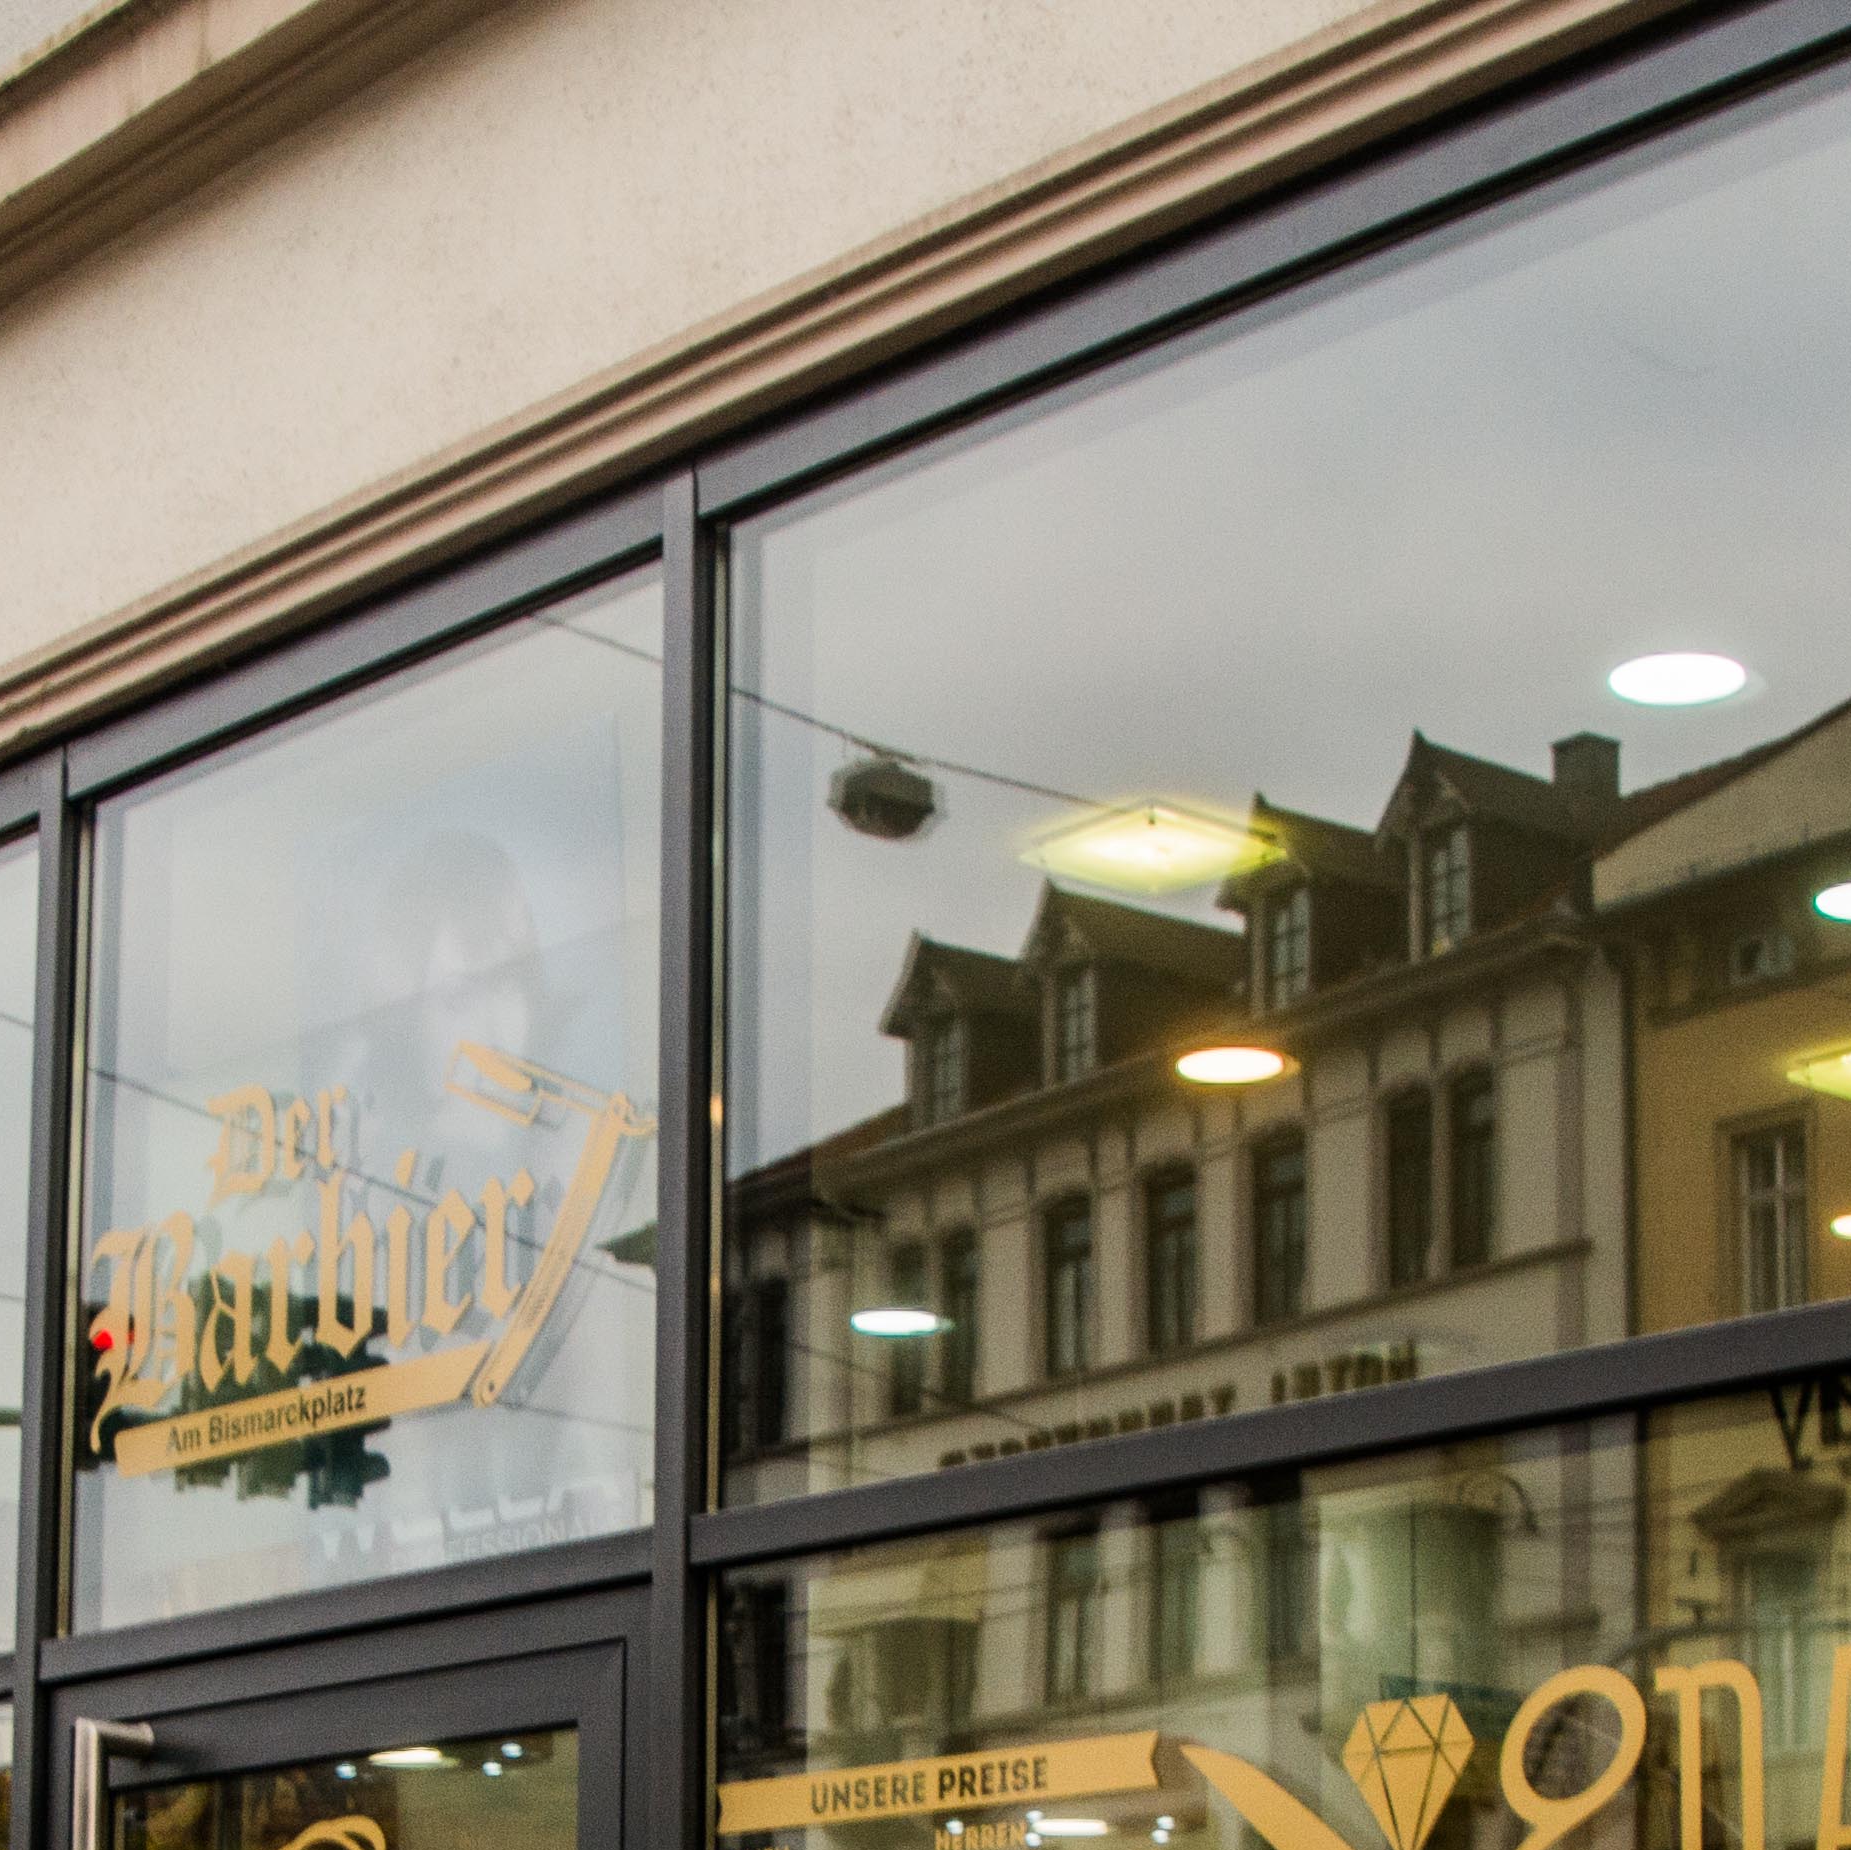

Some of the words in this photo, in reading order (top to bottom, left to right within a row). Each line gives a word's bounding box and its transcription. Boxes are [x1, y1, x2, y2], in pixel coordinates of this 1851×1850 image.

[206, 1084, 346, 1208] Der
[90, 1150, 535, 1453] Barbier
[166, 1425, 201, 1456] Am
[208, 1383, 367, 1447] Bismarckplatz
[811, 1769, 926, 1815] UNSERE
[938, 1754, 1049, 1801] PREISE
